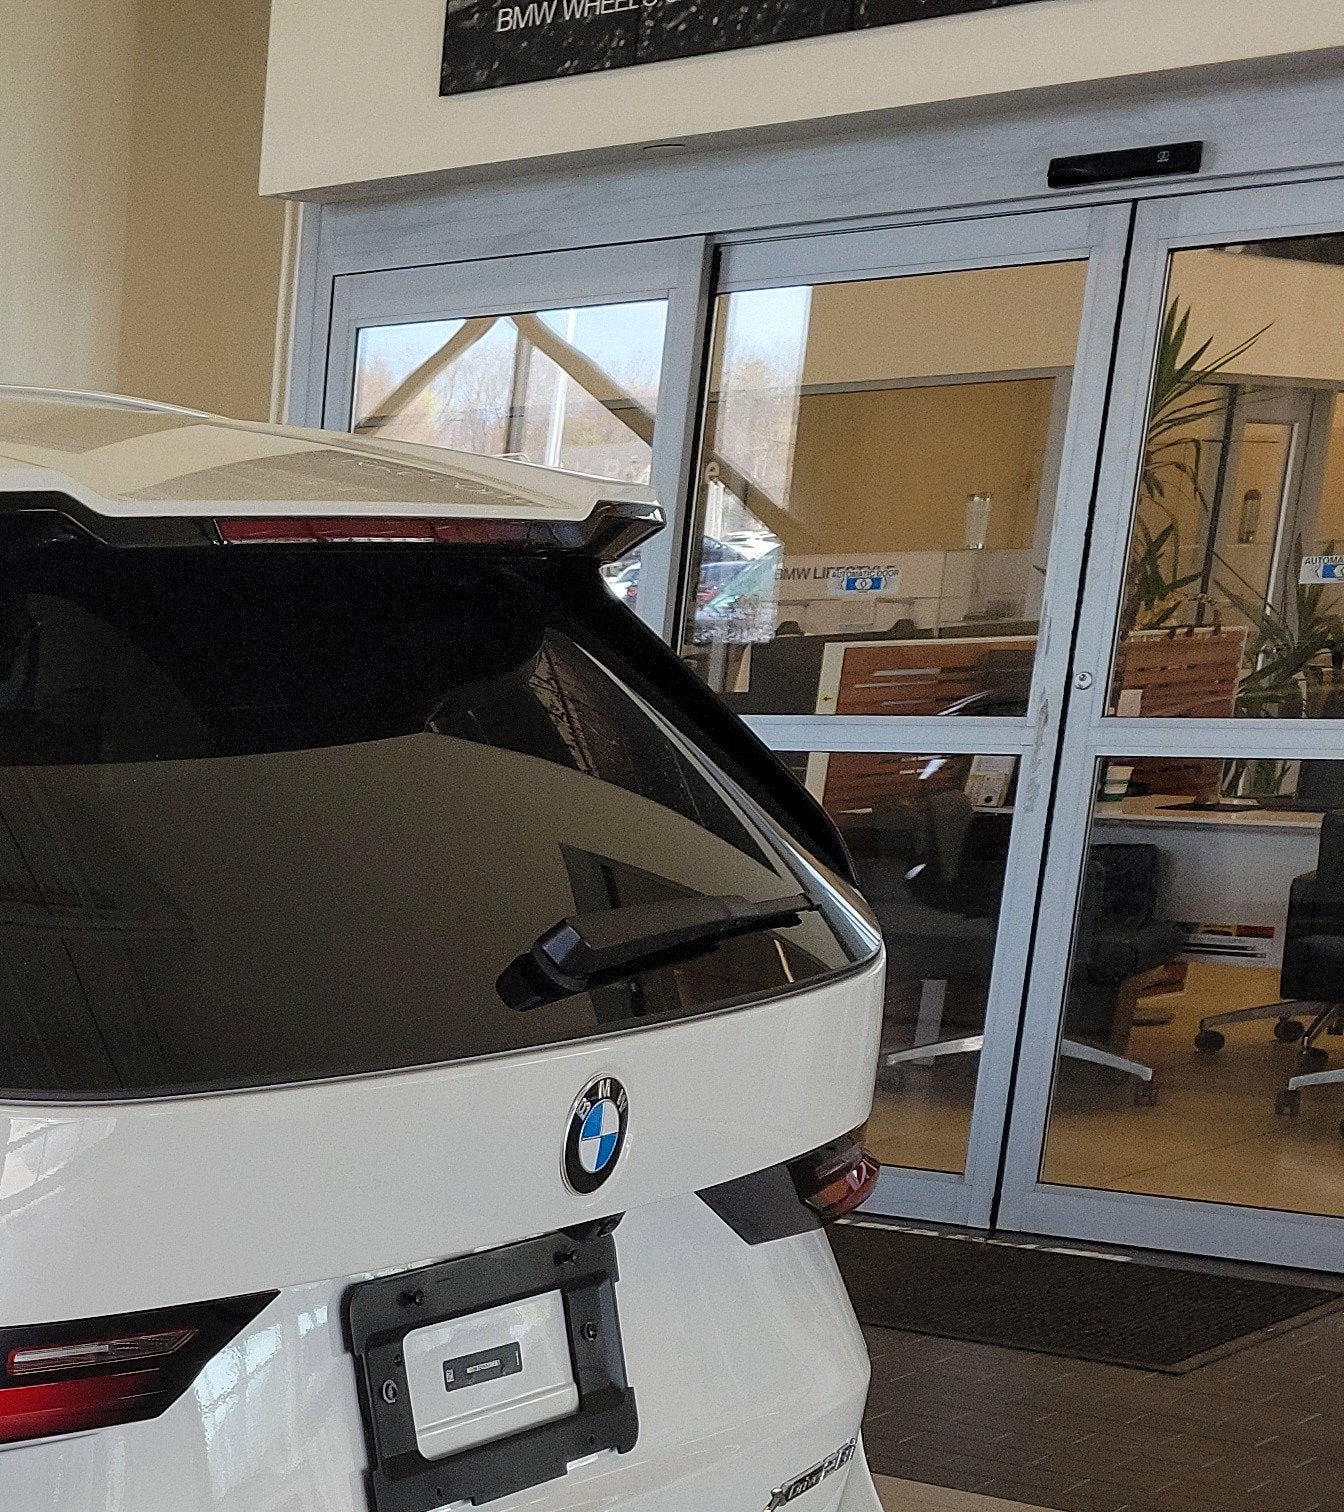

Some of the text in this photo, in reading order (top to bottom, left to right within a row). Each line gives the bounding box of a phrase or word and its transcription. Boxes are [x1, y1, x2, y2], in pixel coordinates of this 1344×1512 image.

[497, 0, 657, 32] BMW WHEE
[832, 570, 875, 579] AUTOMATIC
[876, 569, 900, 577] DOOR
[575, 1078, 629, 1121] BMW
